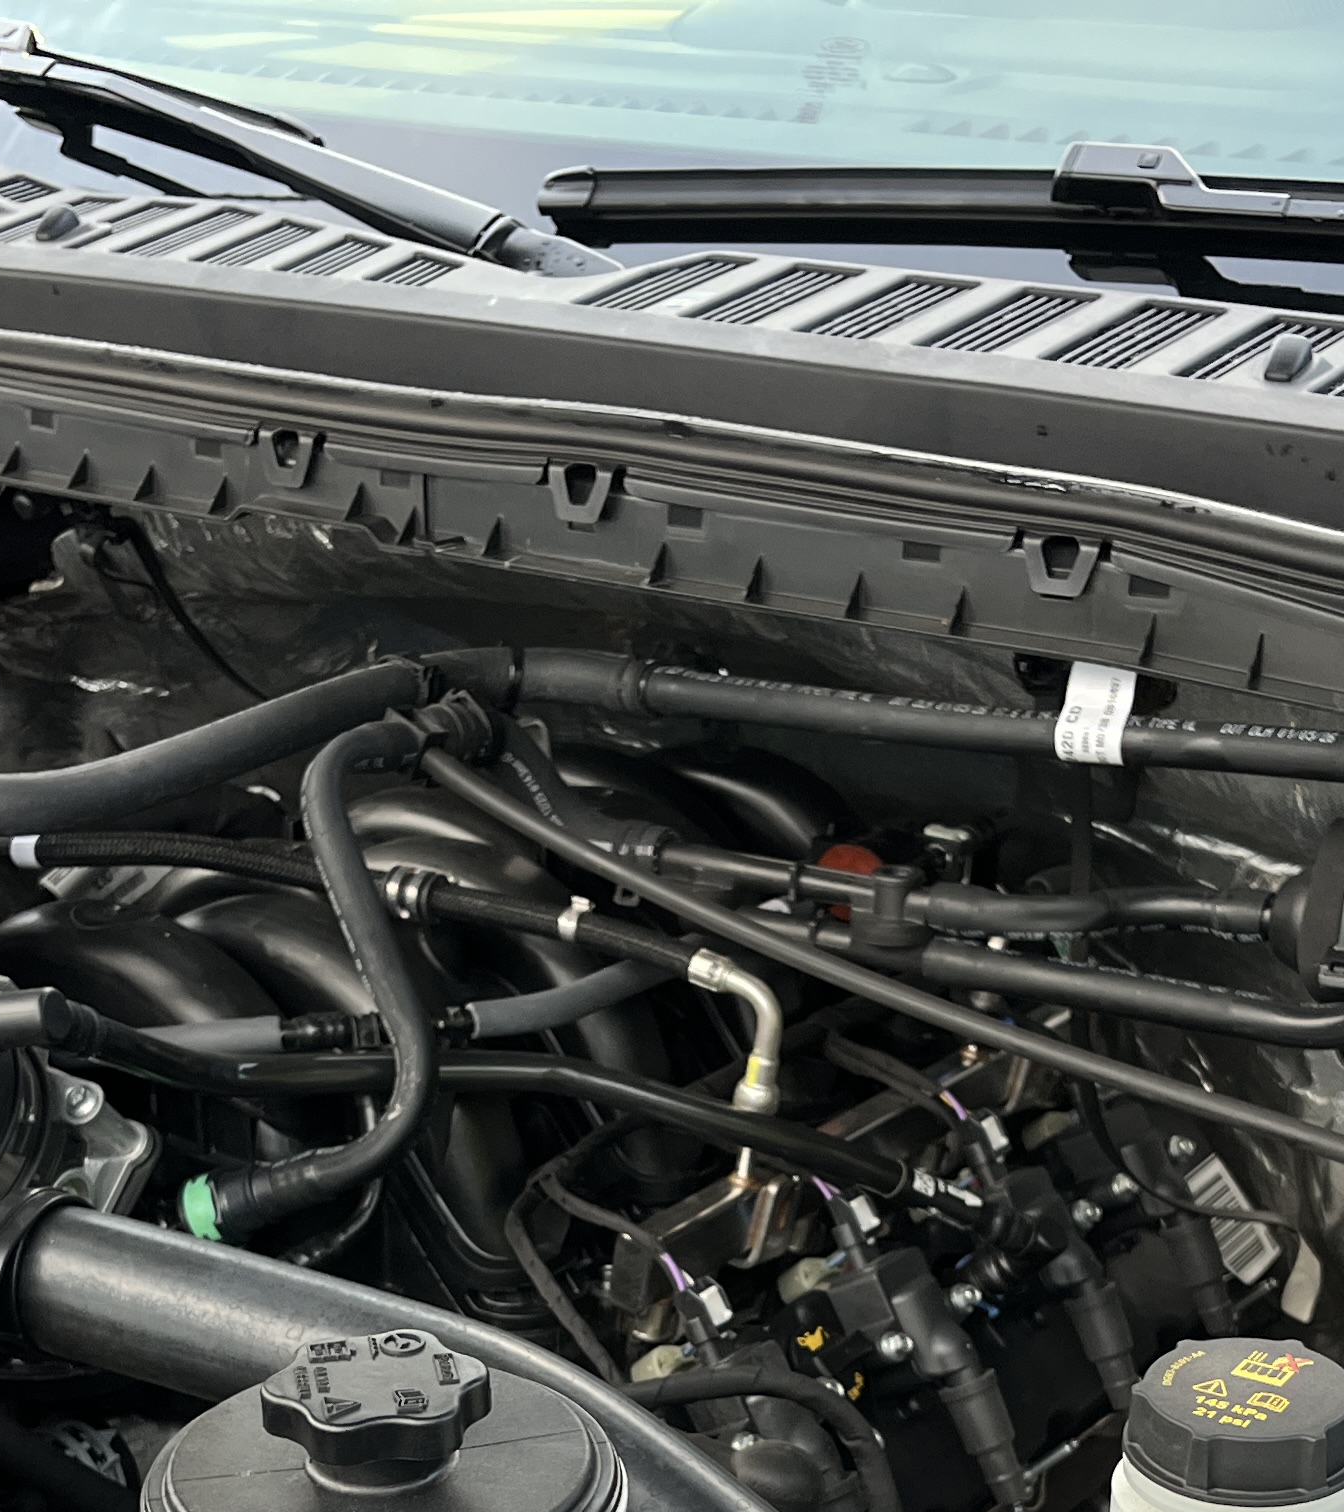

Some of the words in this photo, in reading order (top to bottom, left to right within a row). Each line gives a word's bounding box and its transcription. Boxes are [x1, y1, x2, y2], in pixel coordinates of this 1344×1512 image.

[1191, 1406, 1218, 1419] 21
[1218, 1415, 1252, 1429] psi
[1195, 1395, 1230, 1410] 145
[1230, 1404, 1268, 1421] kPa
